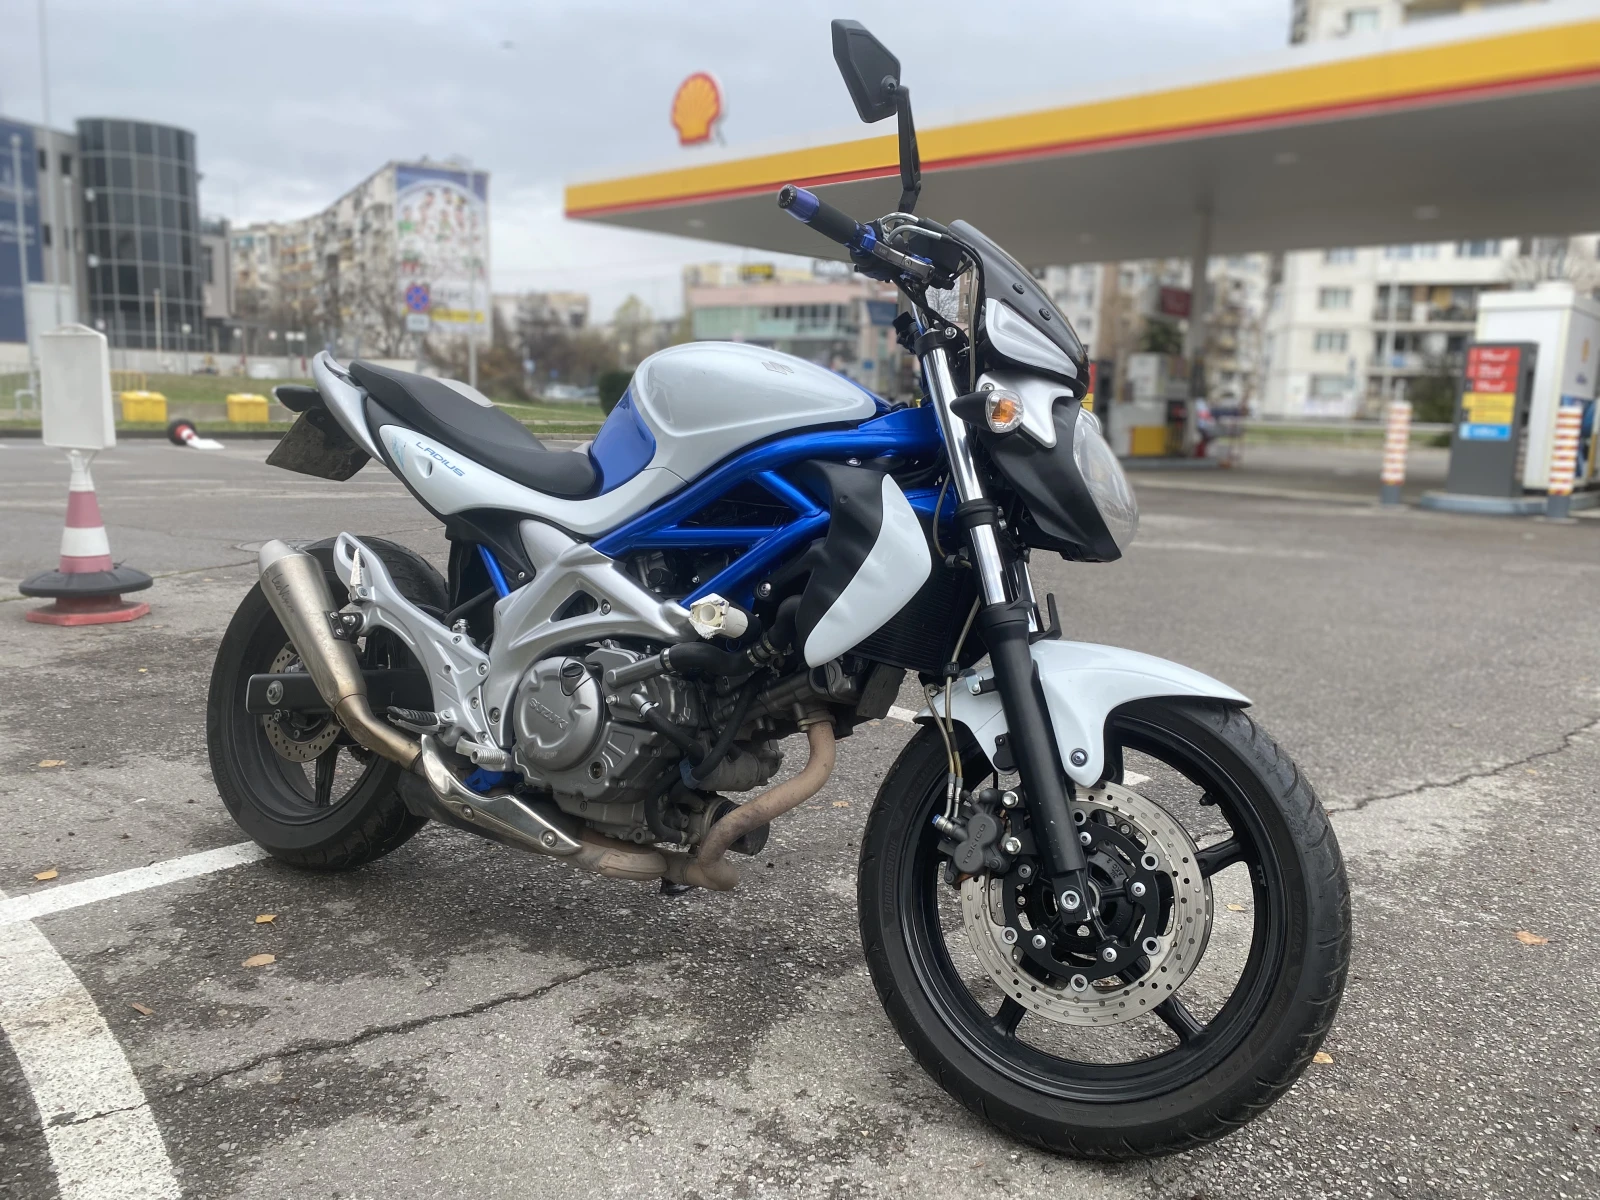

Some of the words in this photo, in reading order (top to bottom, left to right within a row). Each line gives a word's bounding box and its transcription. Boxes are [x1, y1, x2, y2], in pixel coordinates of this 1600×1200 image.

[416, 441, 466, 477] LADIUS
[528, 697, 569, 731] SUZUKI
[962, 823, 986, 864] TOKICO
[884, 837, 900, 914] BRIDGESTONE
